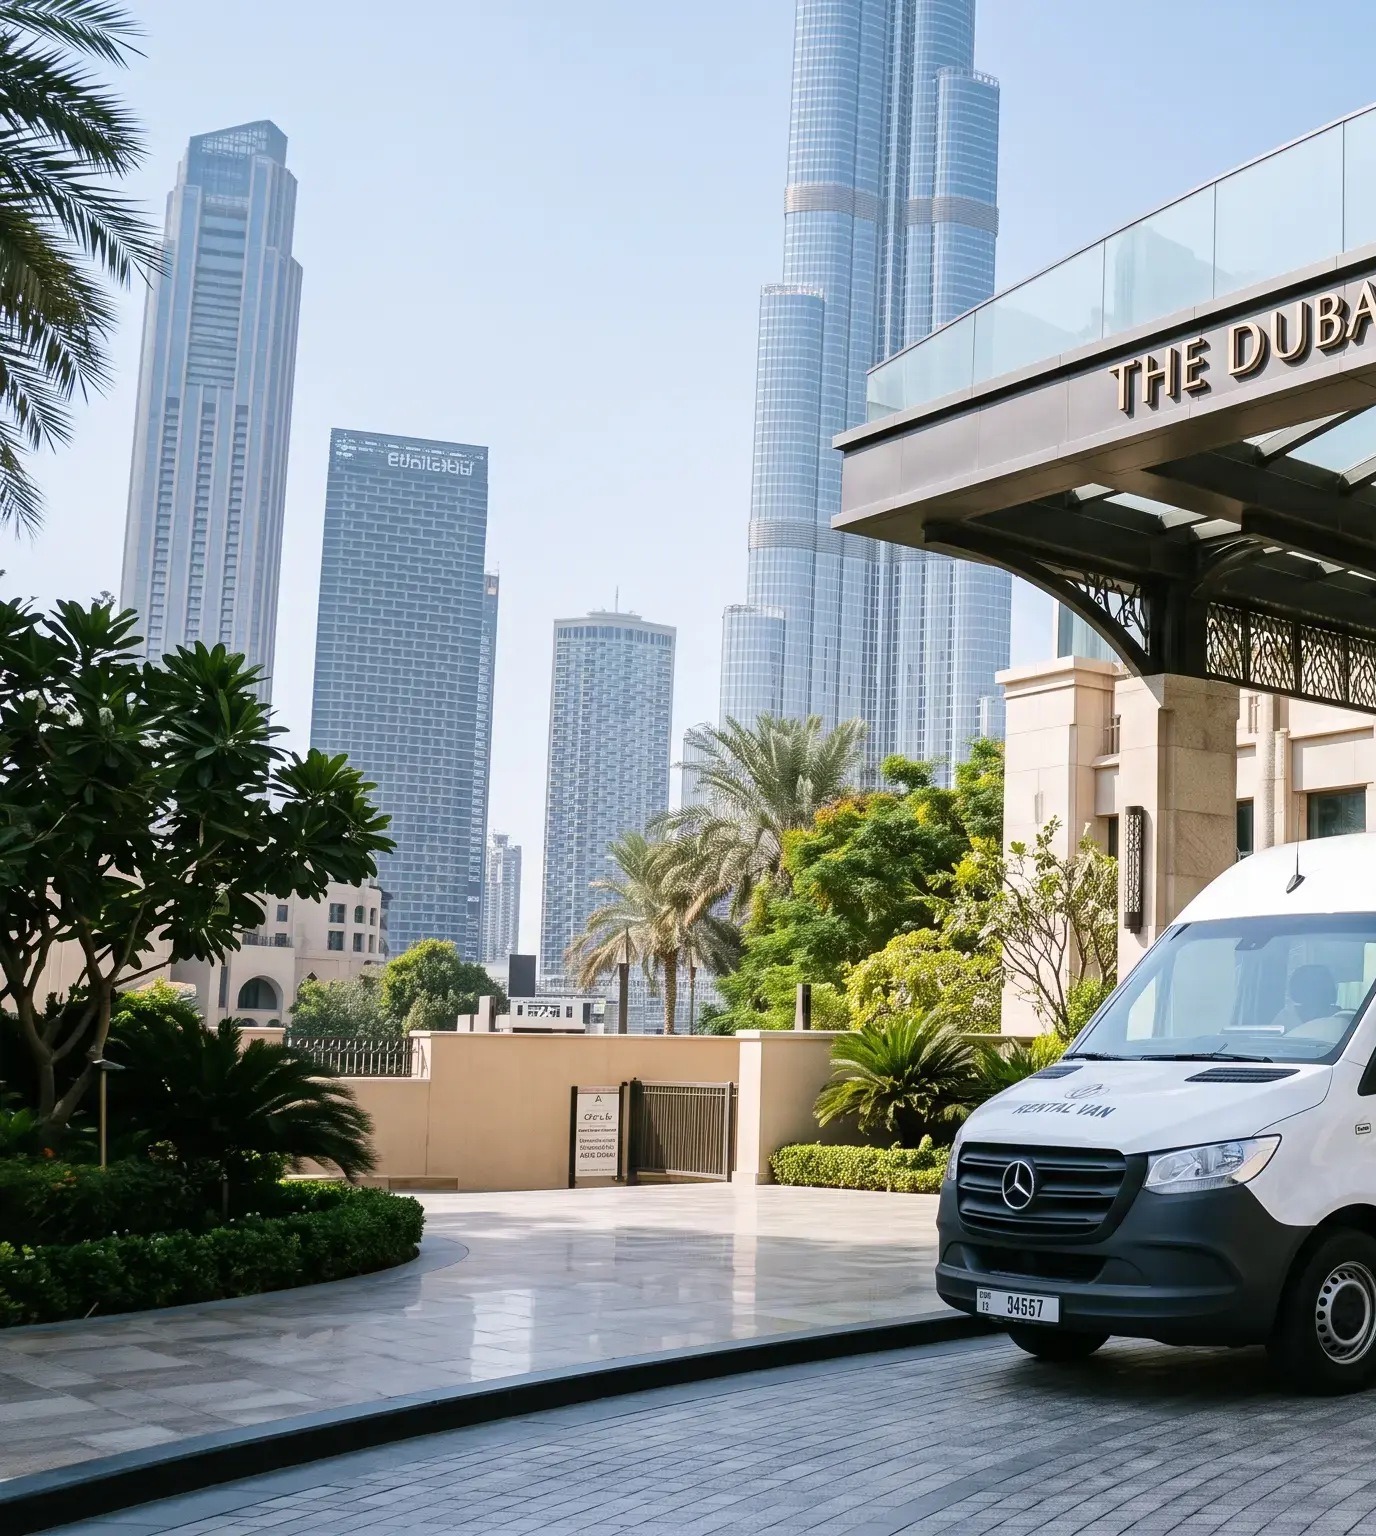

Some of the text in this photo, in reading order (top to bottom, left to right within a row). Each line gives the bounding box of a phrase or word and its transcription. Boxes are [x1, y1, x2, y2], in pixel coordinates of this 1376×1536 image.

[1109, 336, 1210, 414] THE
[1012, 1102, 1117, 1118] RENTAL VAN
